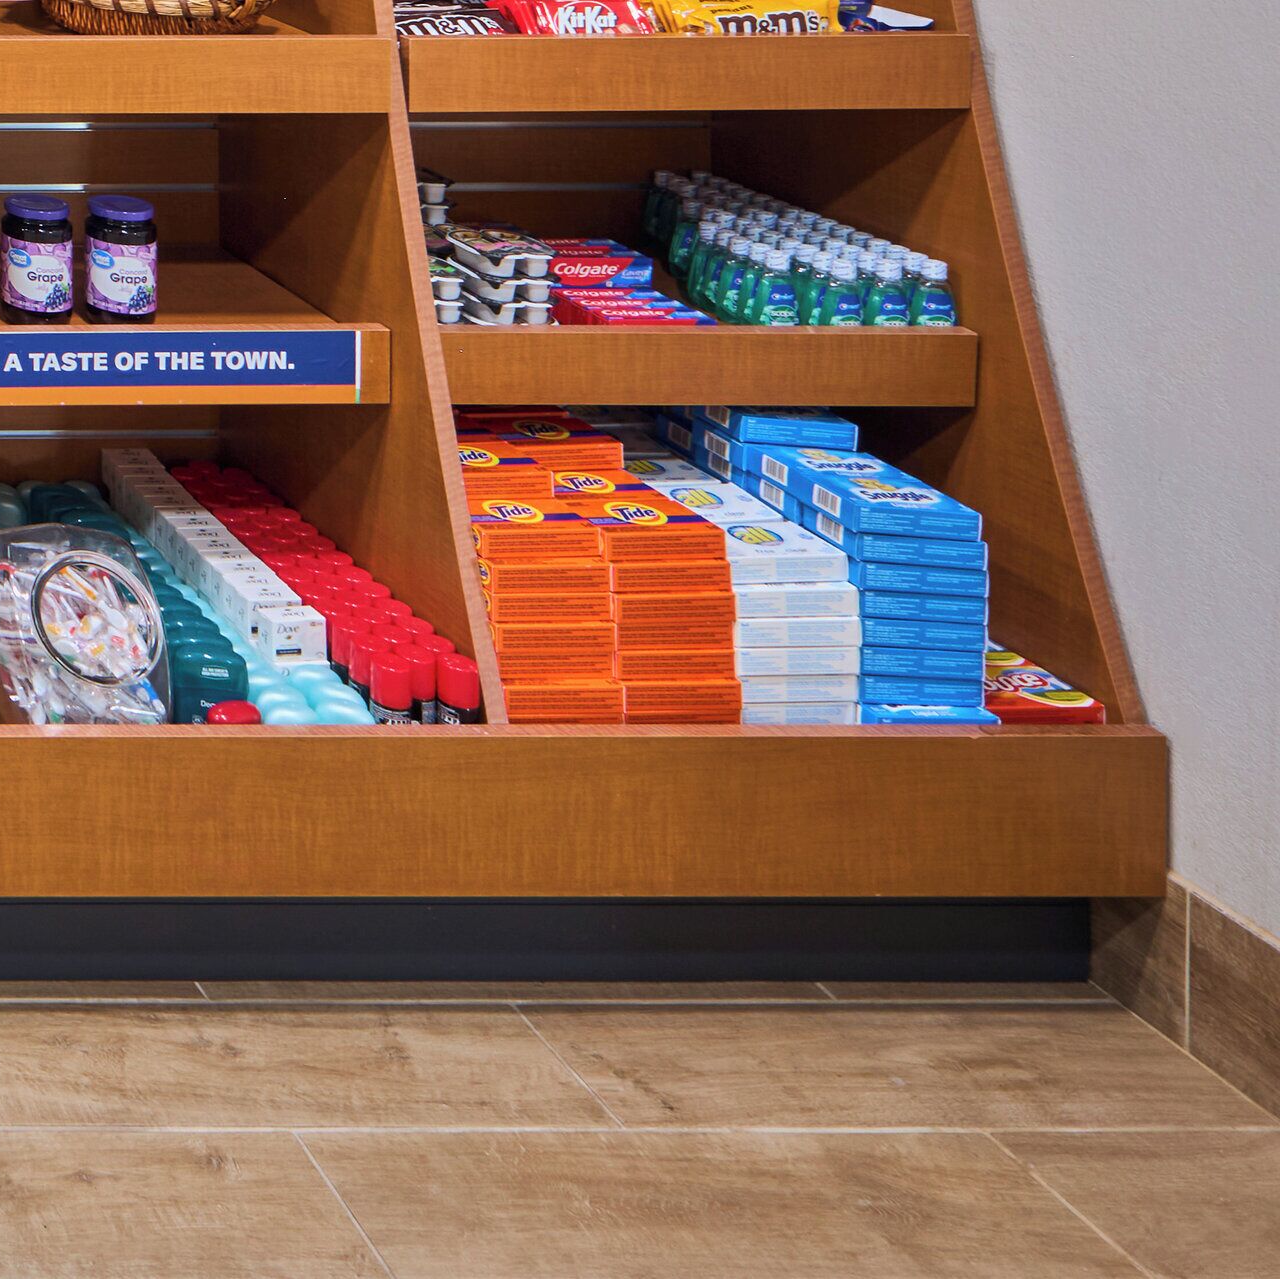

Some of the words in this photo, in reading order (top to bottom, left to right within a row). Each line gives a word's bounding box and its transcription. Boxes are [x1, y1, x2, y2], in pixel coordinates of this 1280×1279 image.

[718, 9, 821, 33] m&m's
[553, 262, 618, 278] Colgate
[26, 271, 64, 285] Grape
[110, 272, 148, 286] Grape
[563, 289, 625, 297] Colgate
[580, 299, 644, 307] Colgate
[601, 308, 666, 317] Colgate
[4, 353, 23, 372] A
[29, 352, 108, 373] TASTE
[114, 351, 149, 372] OF
[154, 351, 205, 371] THE
[211, 350, 296, 371] TOWN.
[524, 423, 559, 436] Tide
[806, 460, 878, 472] Snuggle
[562, 476, 605, 489] Tide
[676, 488, 717, 508] all
[859, 489, 934, 502] Snuggle
[489, 504, 533, 519] Tide
[610, 506, 657, 522] Tide
[733, 526, 777, 545] all
[276, 624, 300, 634] Dove
